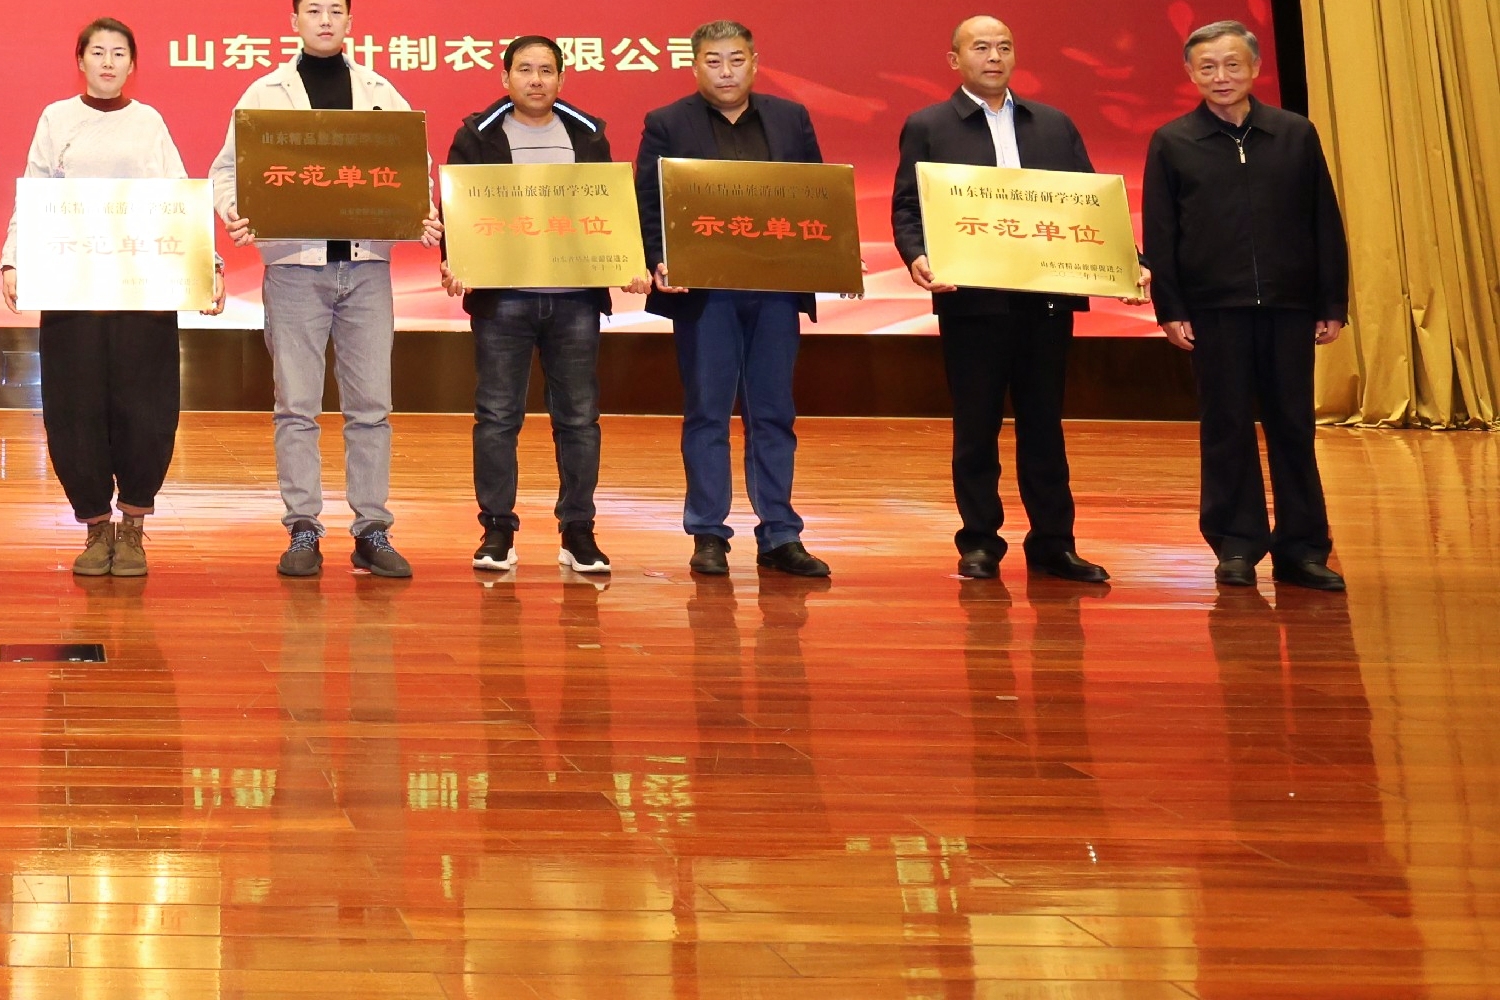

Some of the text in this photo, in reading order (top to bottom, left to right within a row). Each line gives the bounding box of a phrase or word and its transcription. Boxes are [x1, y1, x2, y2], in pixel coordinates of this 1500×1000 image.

[263, 164, 402, 188] 示范单位
[468, 184, 609, 198] 山东精品旅游研学实践
[950, 185, 1100, 207] 山东精品旅游研学实践
[473, 215, 612, 237] 示范单位
[691, 216, 832, 241] 示范单位
[955, 217, 1105, 245] 示范单位
[47, 235, 186, 256] 示范单位
